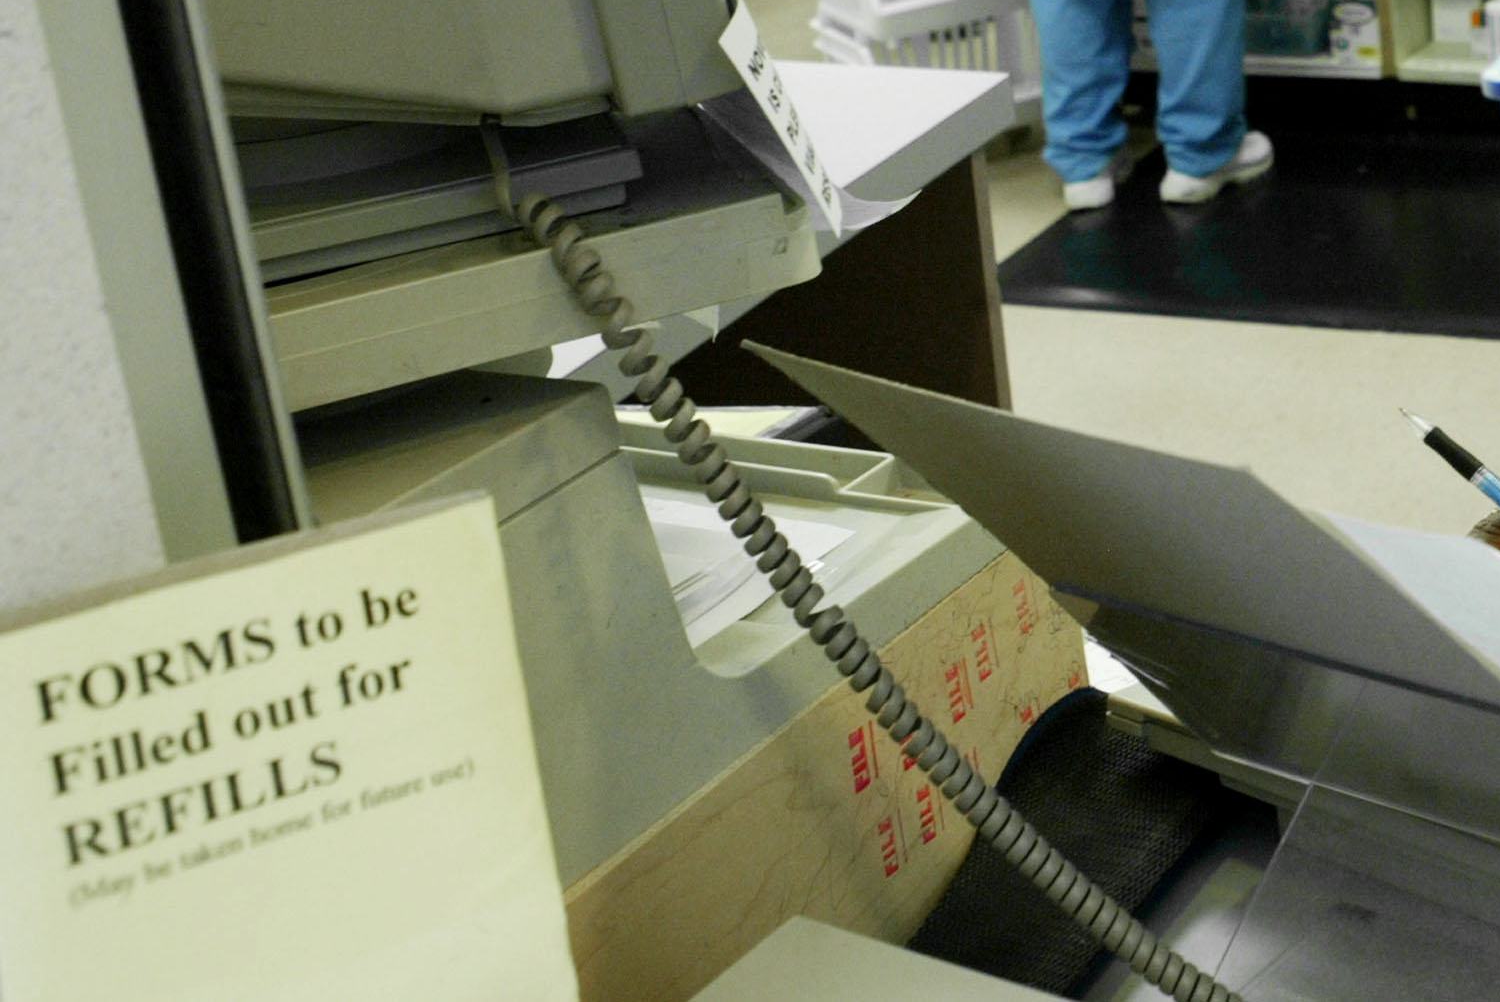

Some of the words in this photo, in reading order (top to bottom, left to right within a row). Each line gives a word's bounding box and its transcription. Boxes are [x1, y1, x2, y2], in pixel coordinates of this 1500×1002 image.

[1012, 578, 1033, 635] FILE
[34, 616, 276, 725] FORMS
[294, 611, 345, 649] to
[359, 586, 419, 630] be
[971, 624, 992, 682] FILE
[47, 710, 213, 797] Filled
[232, 681, 319, 740] out
[337, 656, 411, 708] for
[945, 663, 966, 725] FILE
[848, 726, 872, 794] FILE
[60, 740, 343, 868] REFILLS
[141, 860, 173, 884] be
[179, 837, 245, 872] taken
[249, 814, 313, 848] home
[320, 800, 352, 824] for
[359, 775, 425, 813] future
[429, 757, 475, 791] use)
[916, 785, 937, 845] FILE
[878, 817, 900, 879] FILE
